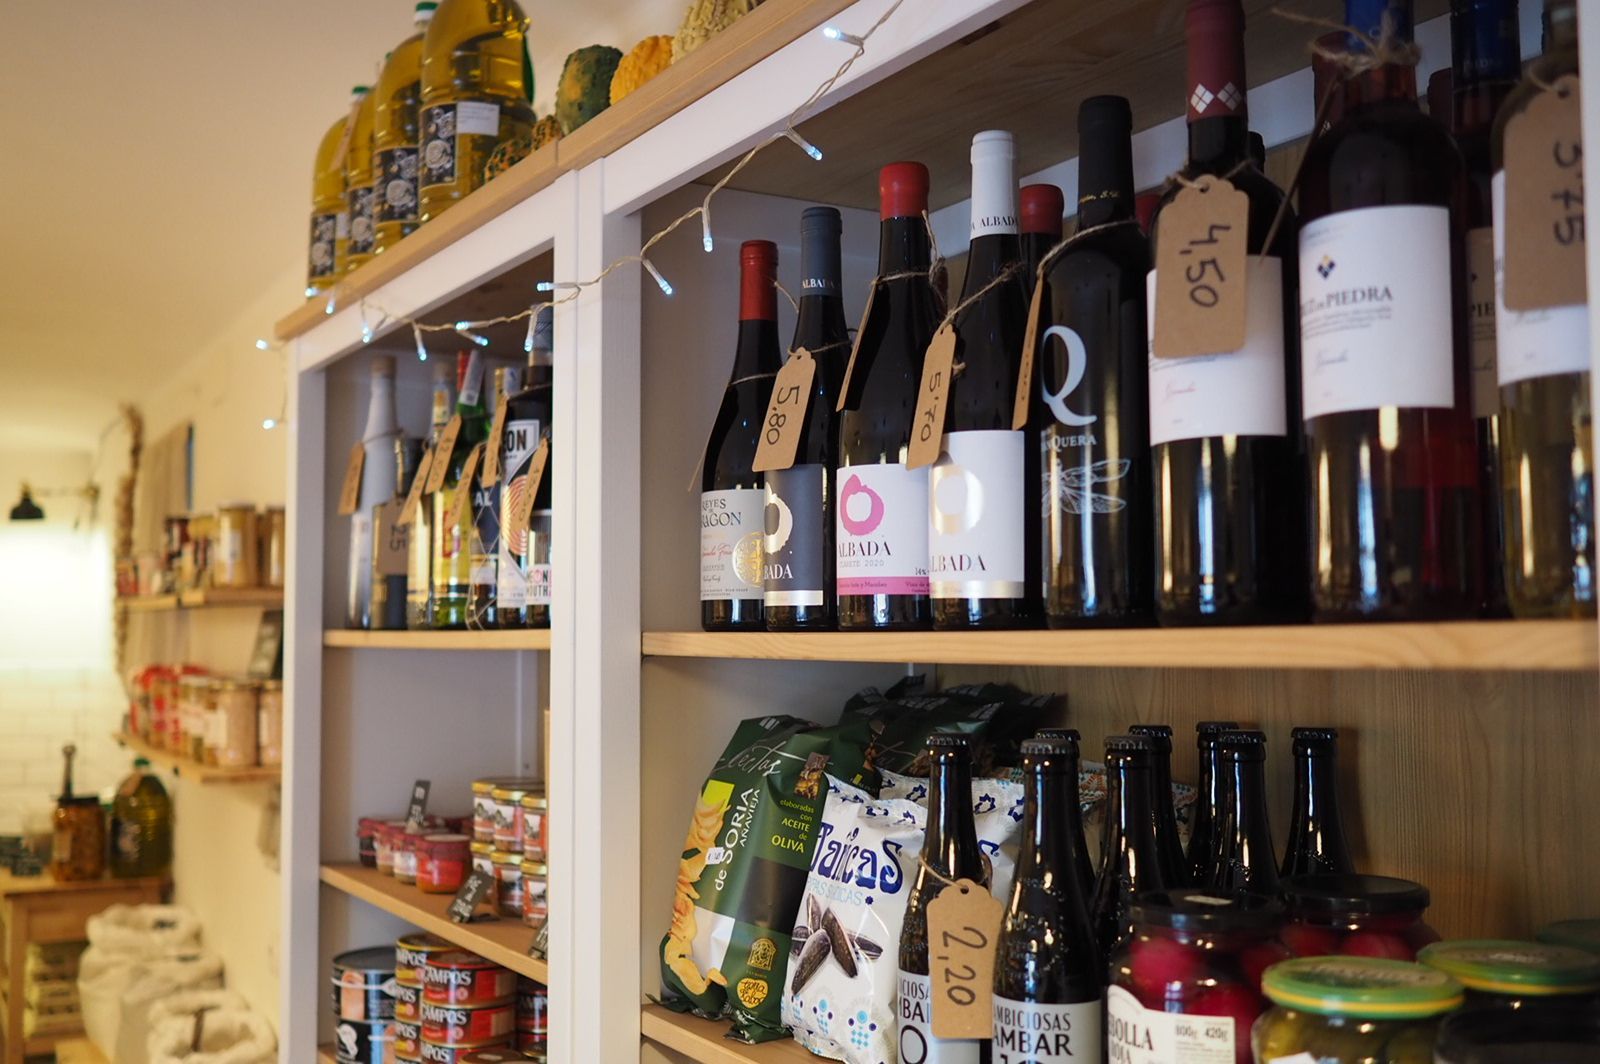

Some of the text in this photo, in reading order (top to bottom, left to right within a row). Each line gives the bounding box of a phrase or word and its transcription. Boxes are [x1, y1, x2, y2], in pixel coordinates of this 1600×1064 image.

[1179, 224, 1231, 308] 4,50
[1325, 285, 1393, 309] PIEDRA
[1042, 325, 1097, 427] Q
[779, 799, 815, 814] elaboradas
[800, 812, 813, 822] con
[720, 788, 754, 865] SORIA
[781, 817, 811, 833] ACEITE
[771, 834, 805, 854] OLIVA
[798, 832, 808, 841] de
[713, 867, 728, 891] de
[423, 965, 472, 986] CAMPOS
[937, 926, 988, 1006] 2,20
